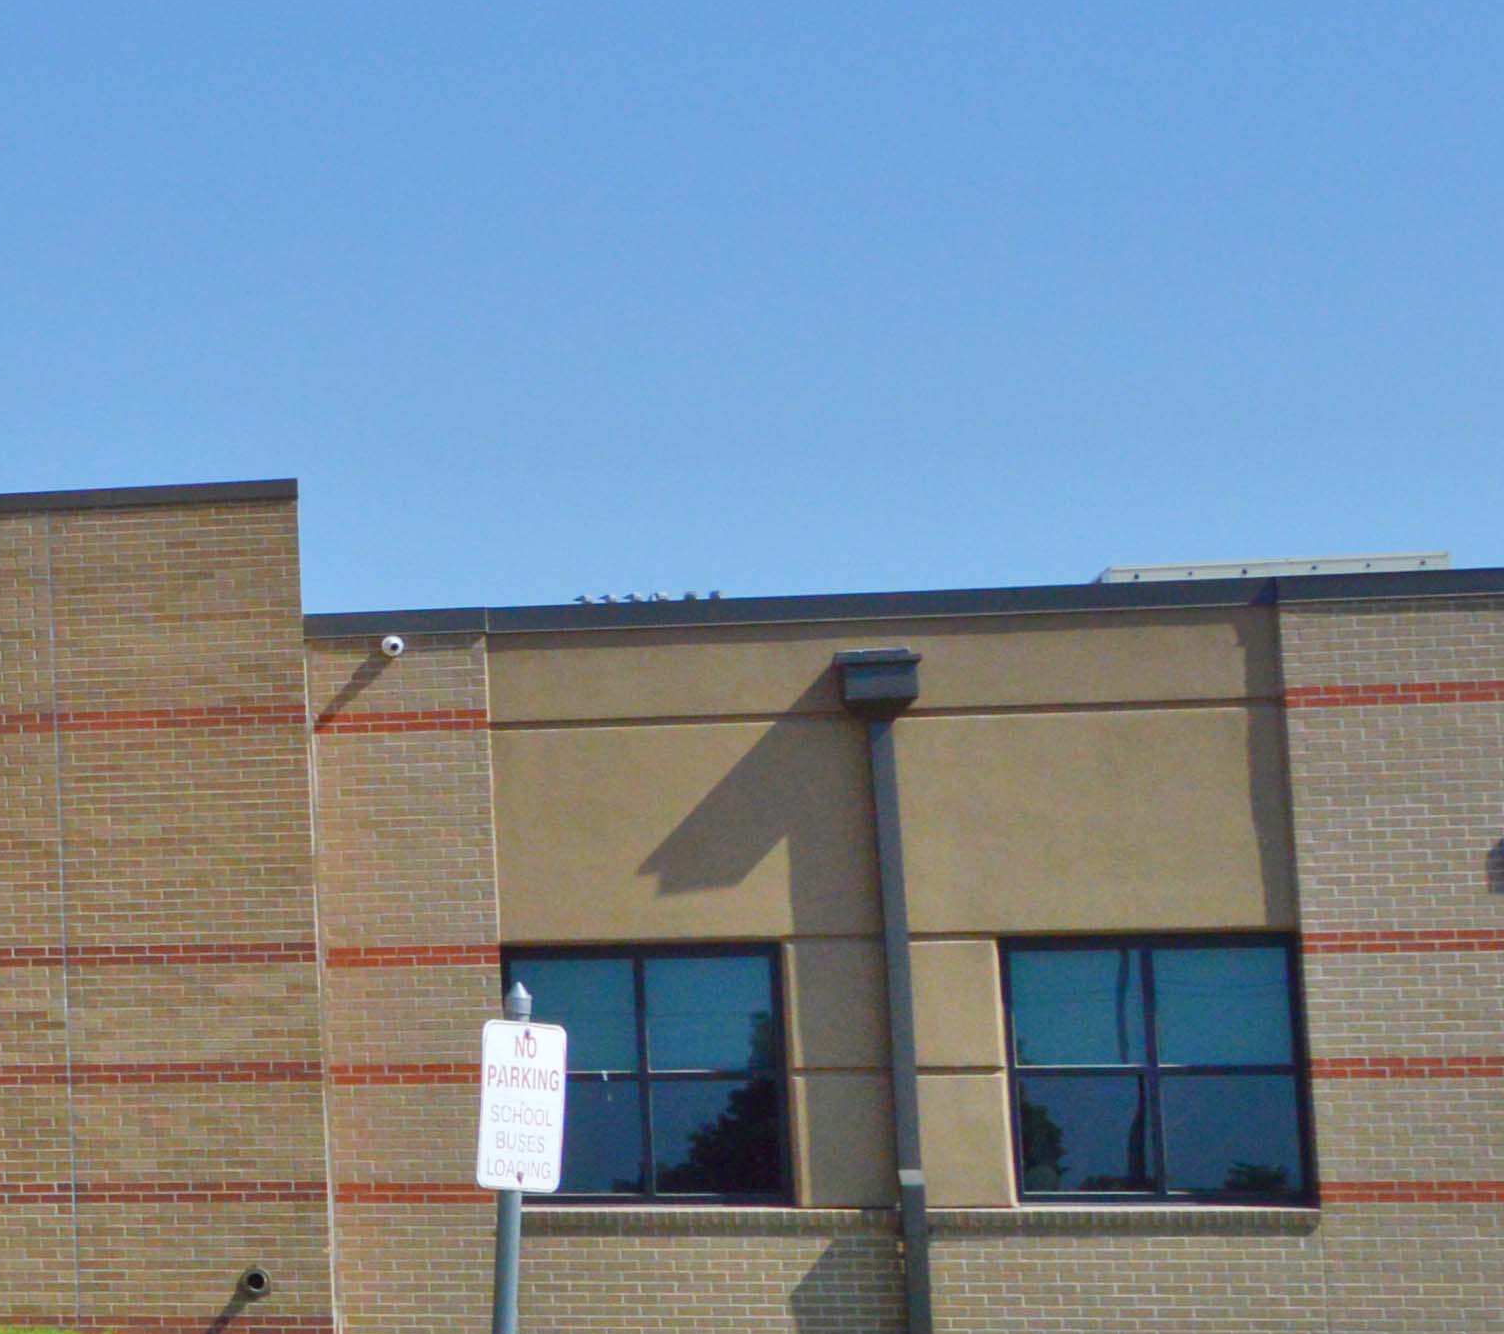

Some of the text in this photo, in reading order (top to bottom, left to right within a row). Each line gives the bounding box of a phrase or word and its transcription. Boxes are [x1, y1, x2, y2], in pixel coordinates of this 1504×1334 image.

[514, 1034, 538, 1060] NO
[487, 1064, 560, 1092] PARKING
[490, 1104, 553, 1127] SCHOOL
[496, 1130, 545, 1154] BUSES
